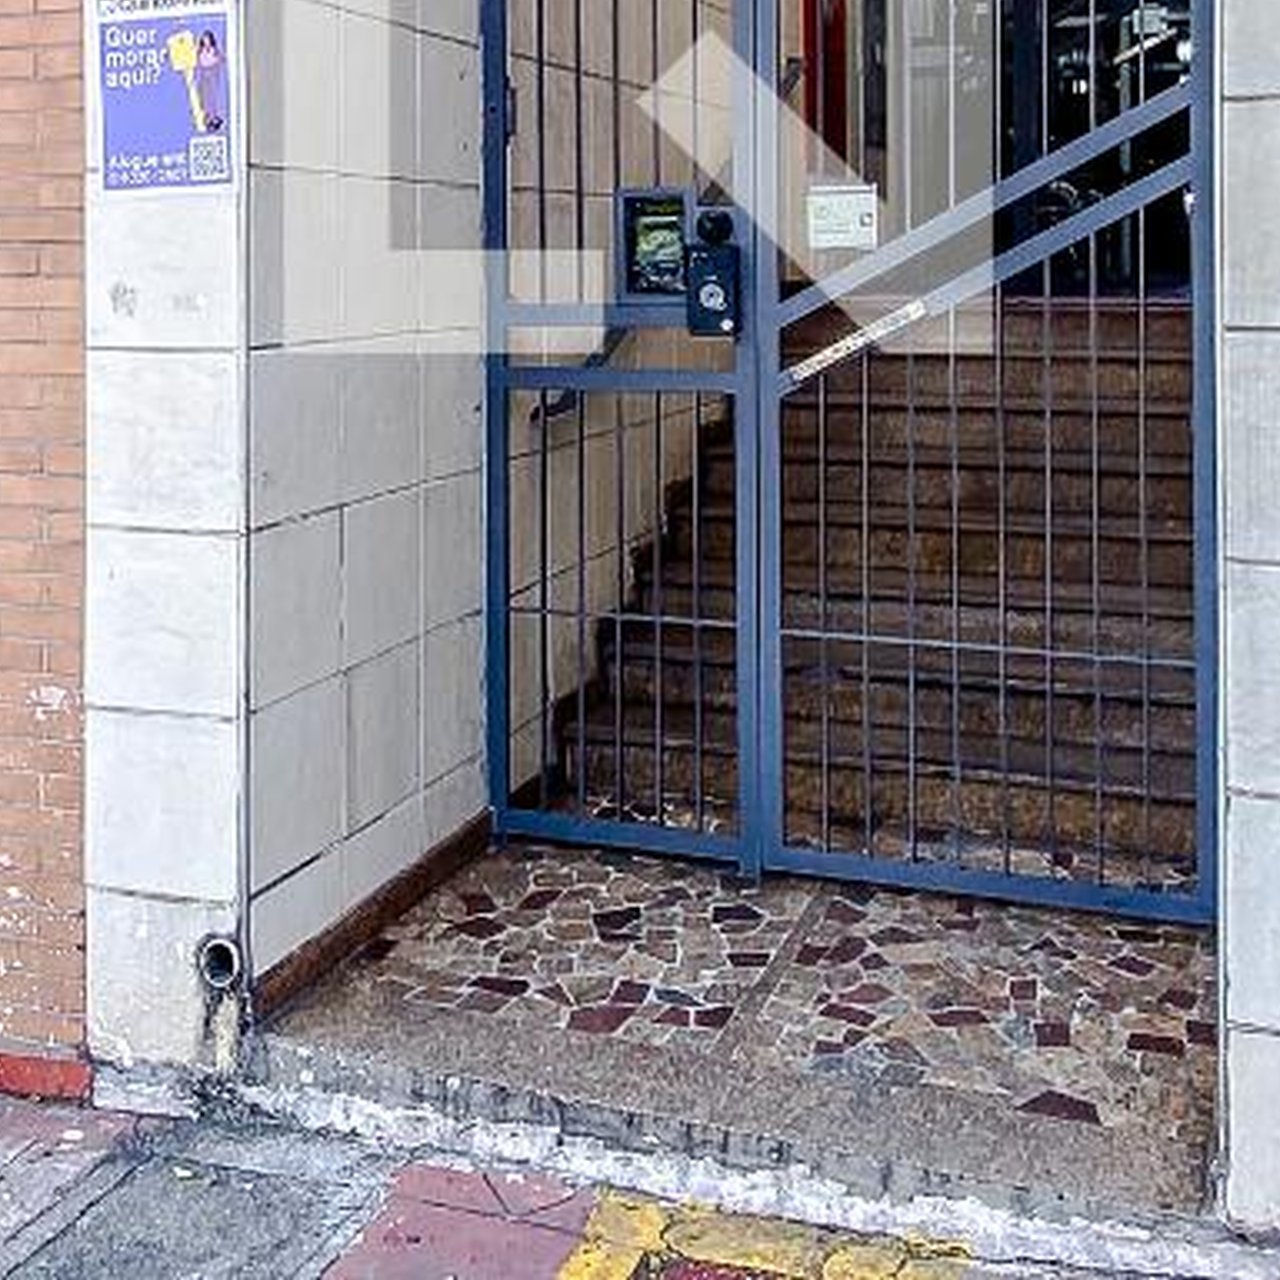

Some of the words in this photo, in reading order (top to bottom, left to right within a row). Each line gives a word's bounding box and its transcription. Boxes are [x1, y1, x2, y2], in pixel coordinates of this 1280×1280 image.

[105, 25, 157, 47] Quer
[105, 47, 168, 69] morar
[105, 67, 162, 90] aqui?
